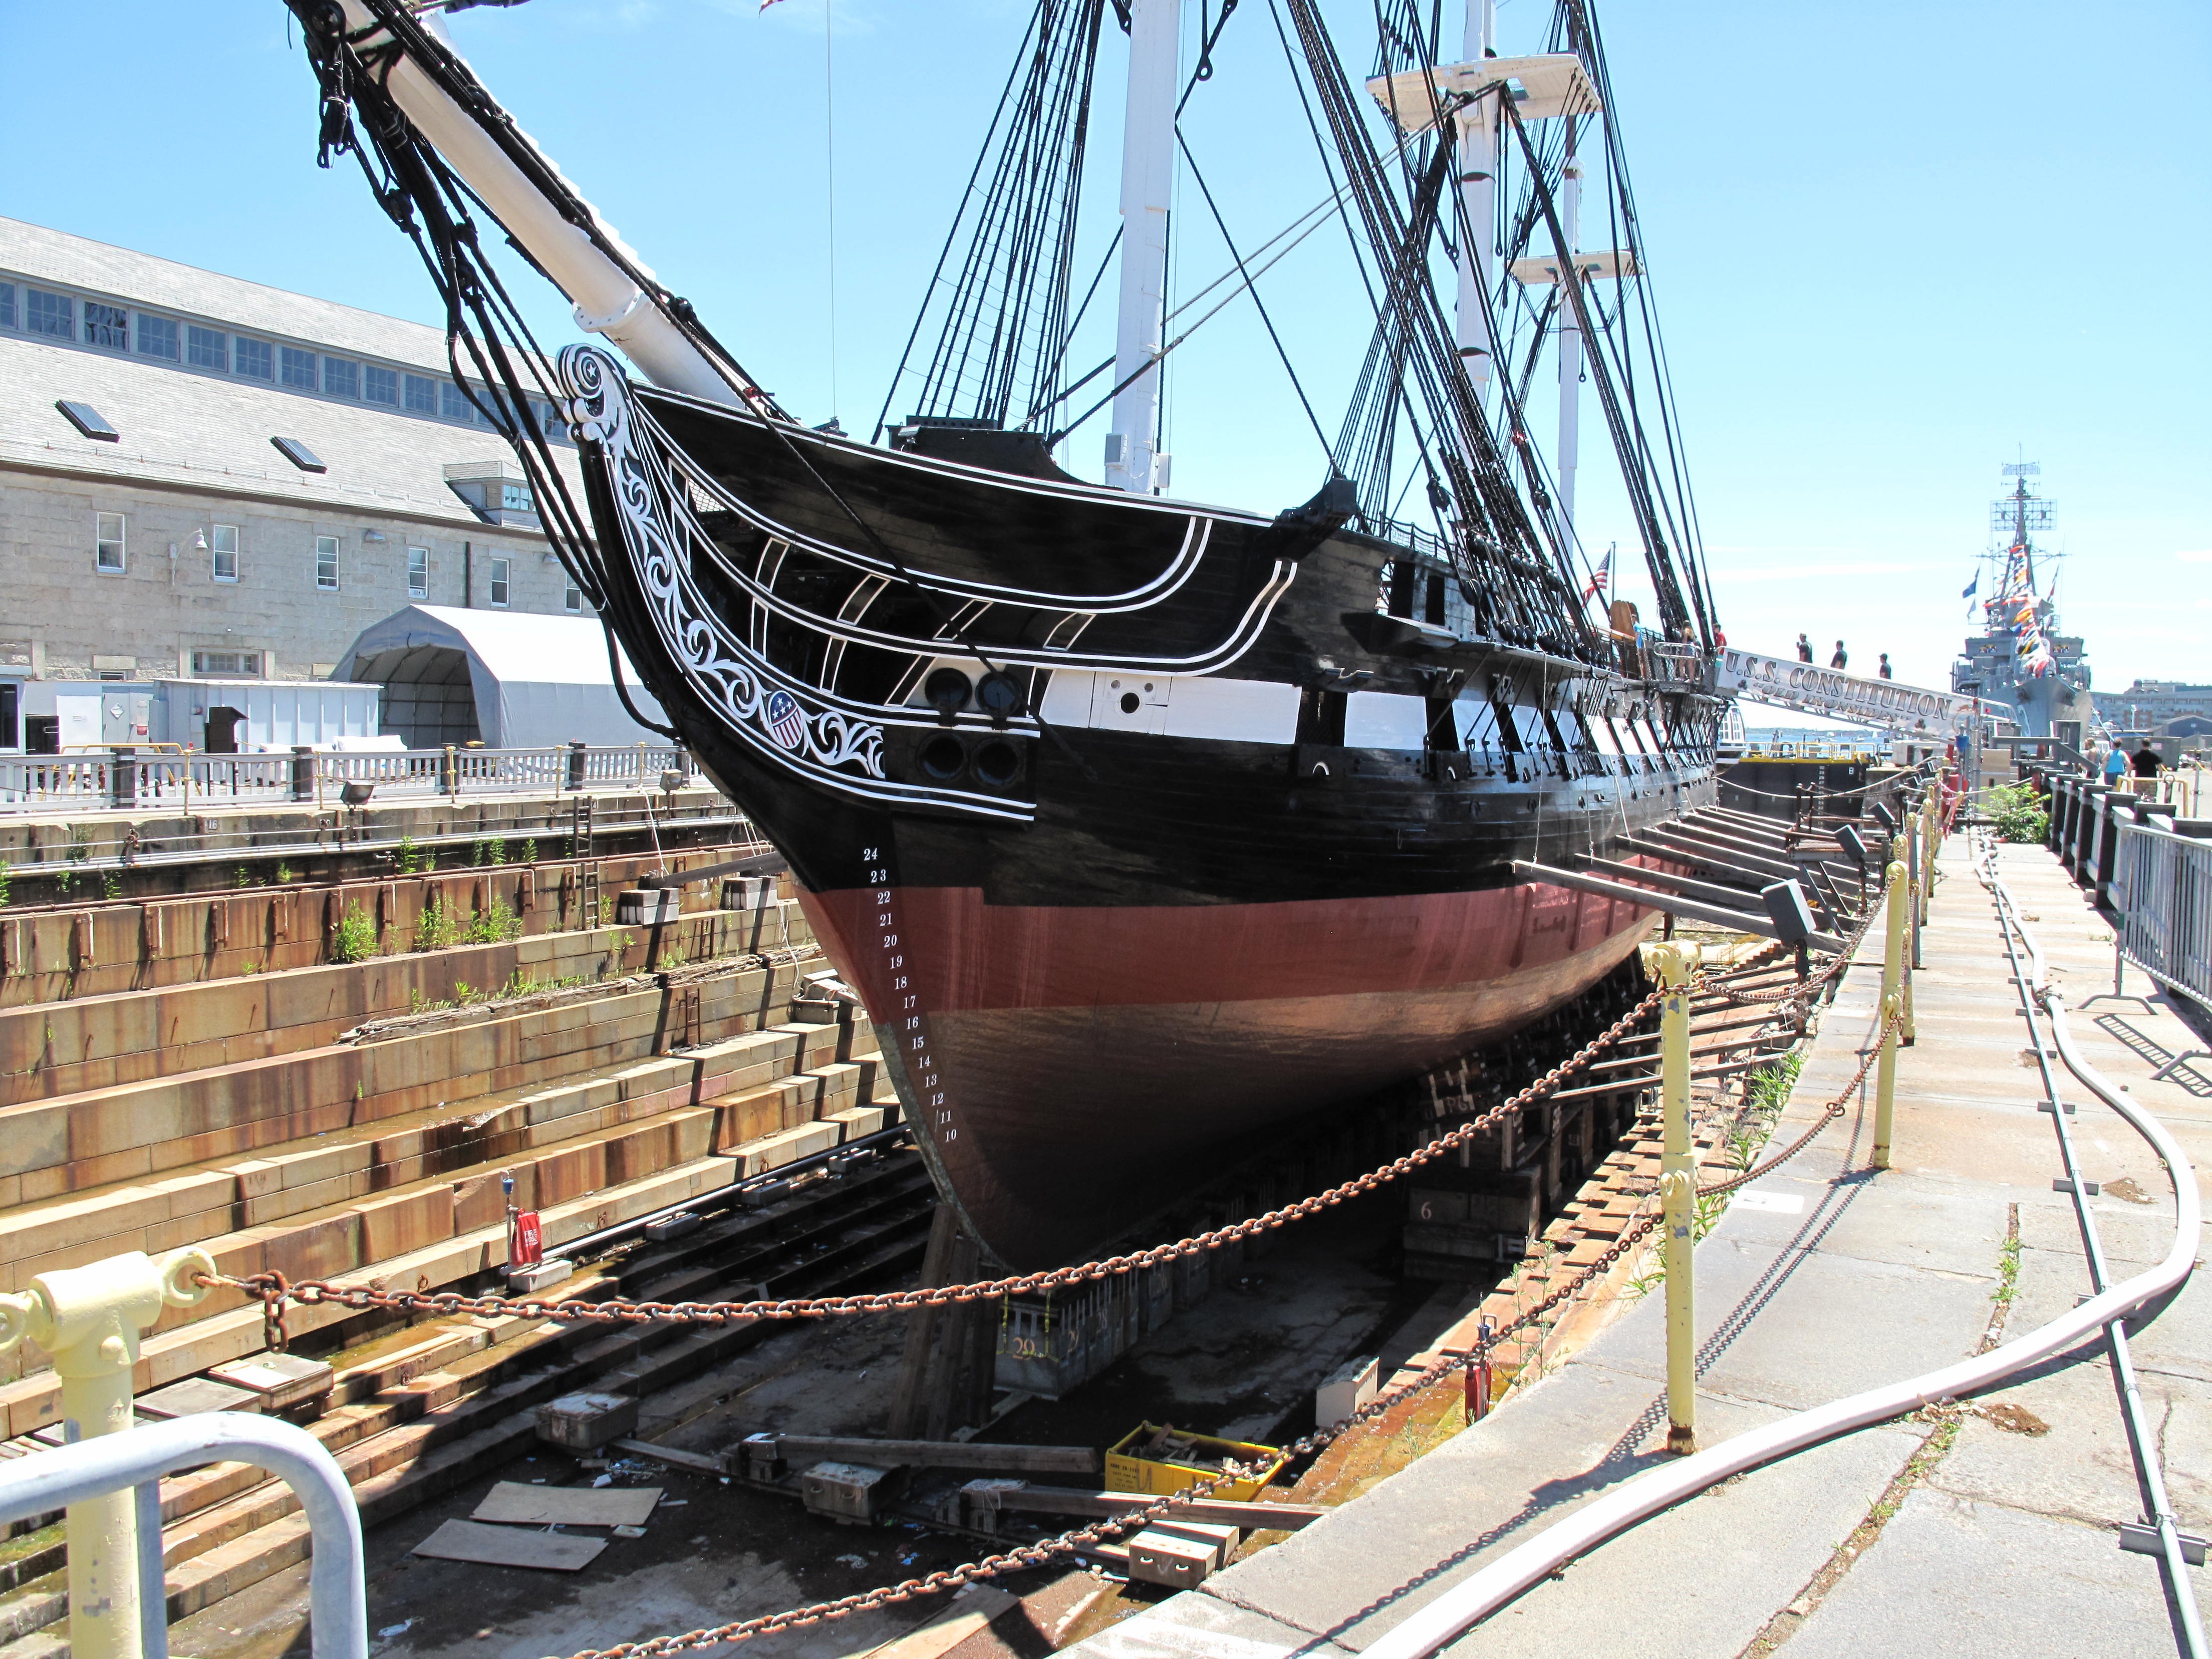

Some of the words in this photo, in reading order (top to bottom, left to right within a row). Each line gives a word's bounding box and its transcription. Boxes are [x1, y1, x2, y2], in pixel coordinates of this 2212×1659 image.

[1726, 652, 1780, 684] U.S.S.
[1790, 667, 1952, 720] CONSTITUTION
[864, 848, 878, 861] 24
[871, 869, 886, 883] 23
[878, 891, 891, 905] 22
[880, 913, 892, 927] 21
[884, 935, 897, 948] 20
[890, 955, 903, 969] 19
[895, 976, 907, 990] 18
[904, 995, 916, 1009] 17
[906, 1016, 919, 1030] 16
[912, 1036, 924, 1050] 15
[919, 1055, 931, 1069] 14
[925, 1074, 937, 1088] 13
[931, 1092, 944, 1106] 12
[940, 1110, 952, 1124] 11
[945, 1129, 957, 1143] 10
[1421, 1201, 1433, 1220] 6
[524, 1229, 537, 1238] FIRE
[524, 1235, 538, 1243] HOSE
